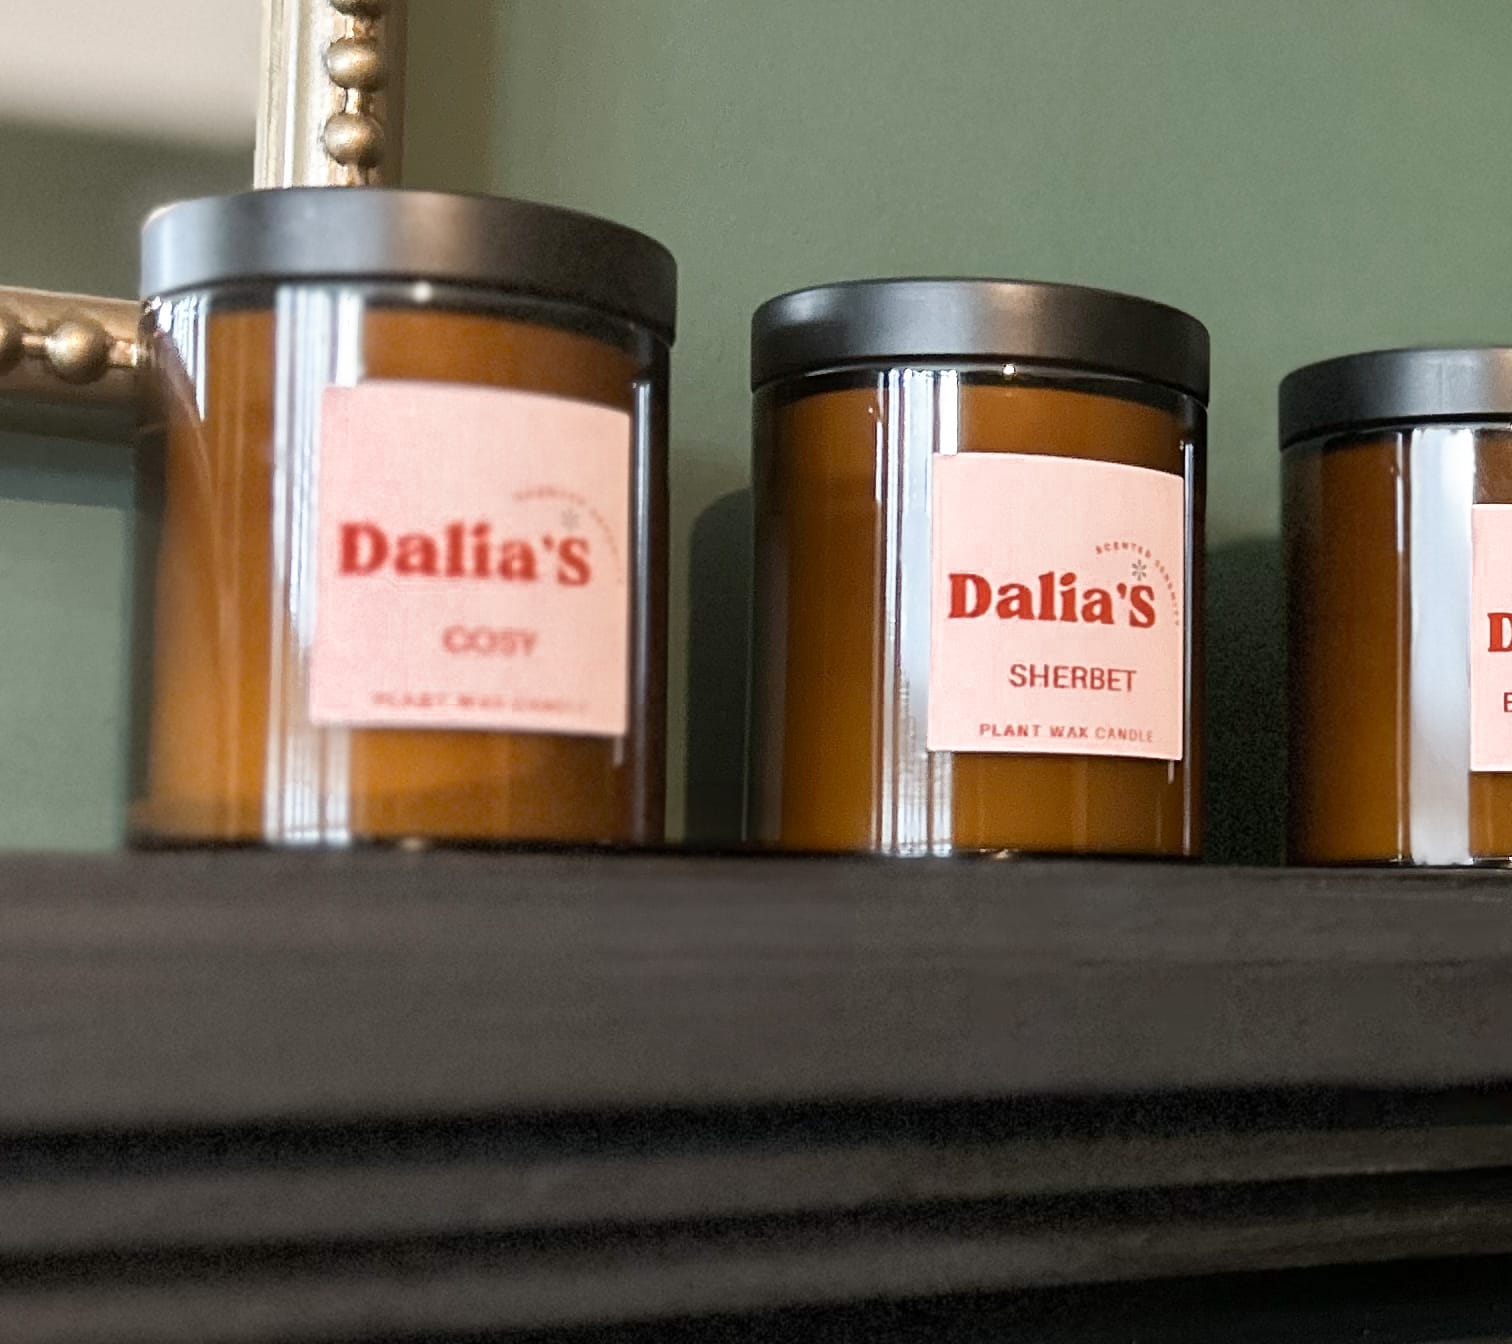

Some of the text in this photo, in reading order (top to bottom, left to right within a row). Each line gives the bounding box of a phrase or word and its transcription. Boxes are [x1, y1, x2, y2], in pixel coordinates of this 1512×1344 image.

[442, 625, 538, 656] COSY
[1008, 664, 1137, 693] SHERBET
[979, 723, 1153, 743] PLANT WAX CANDLE
